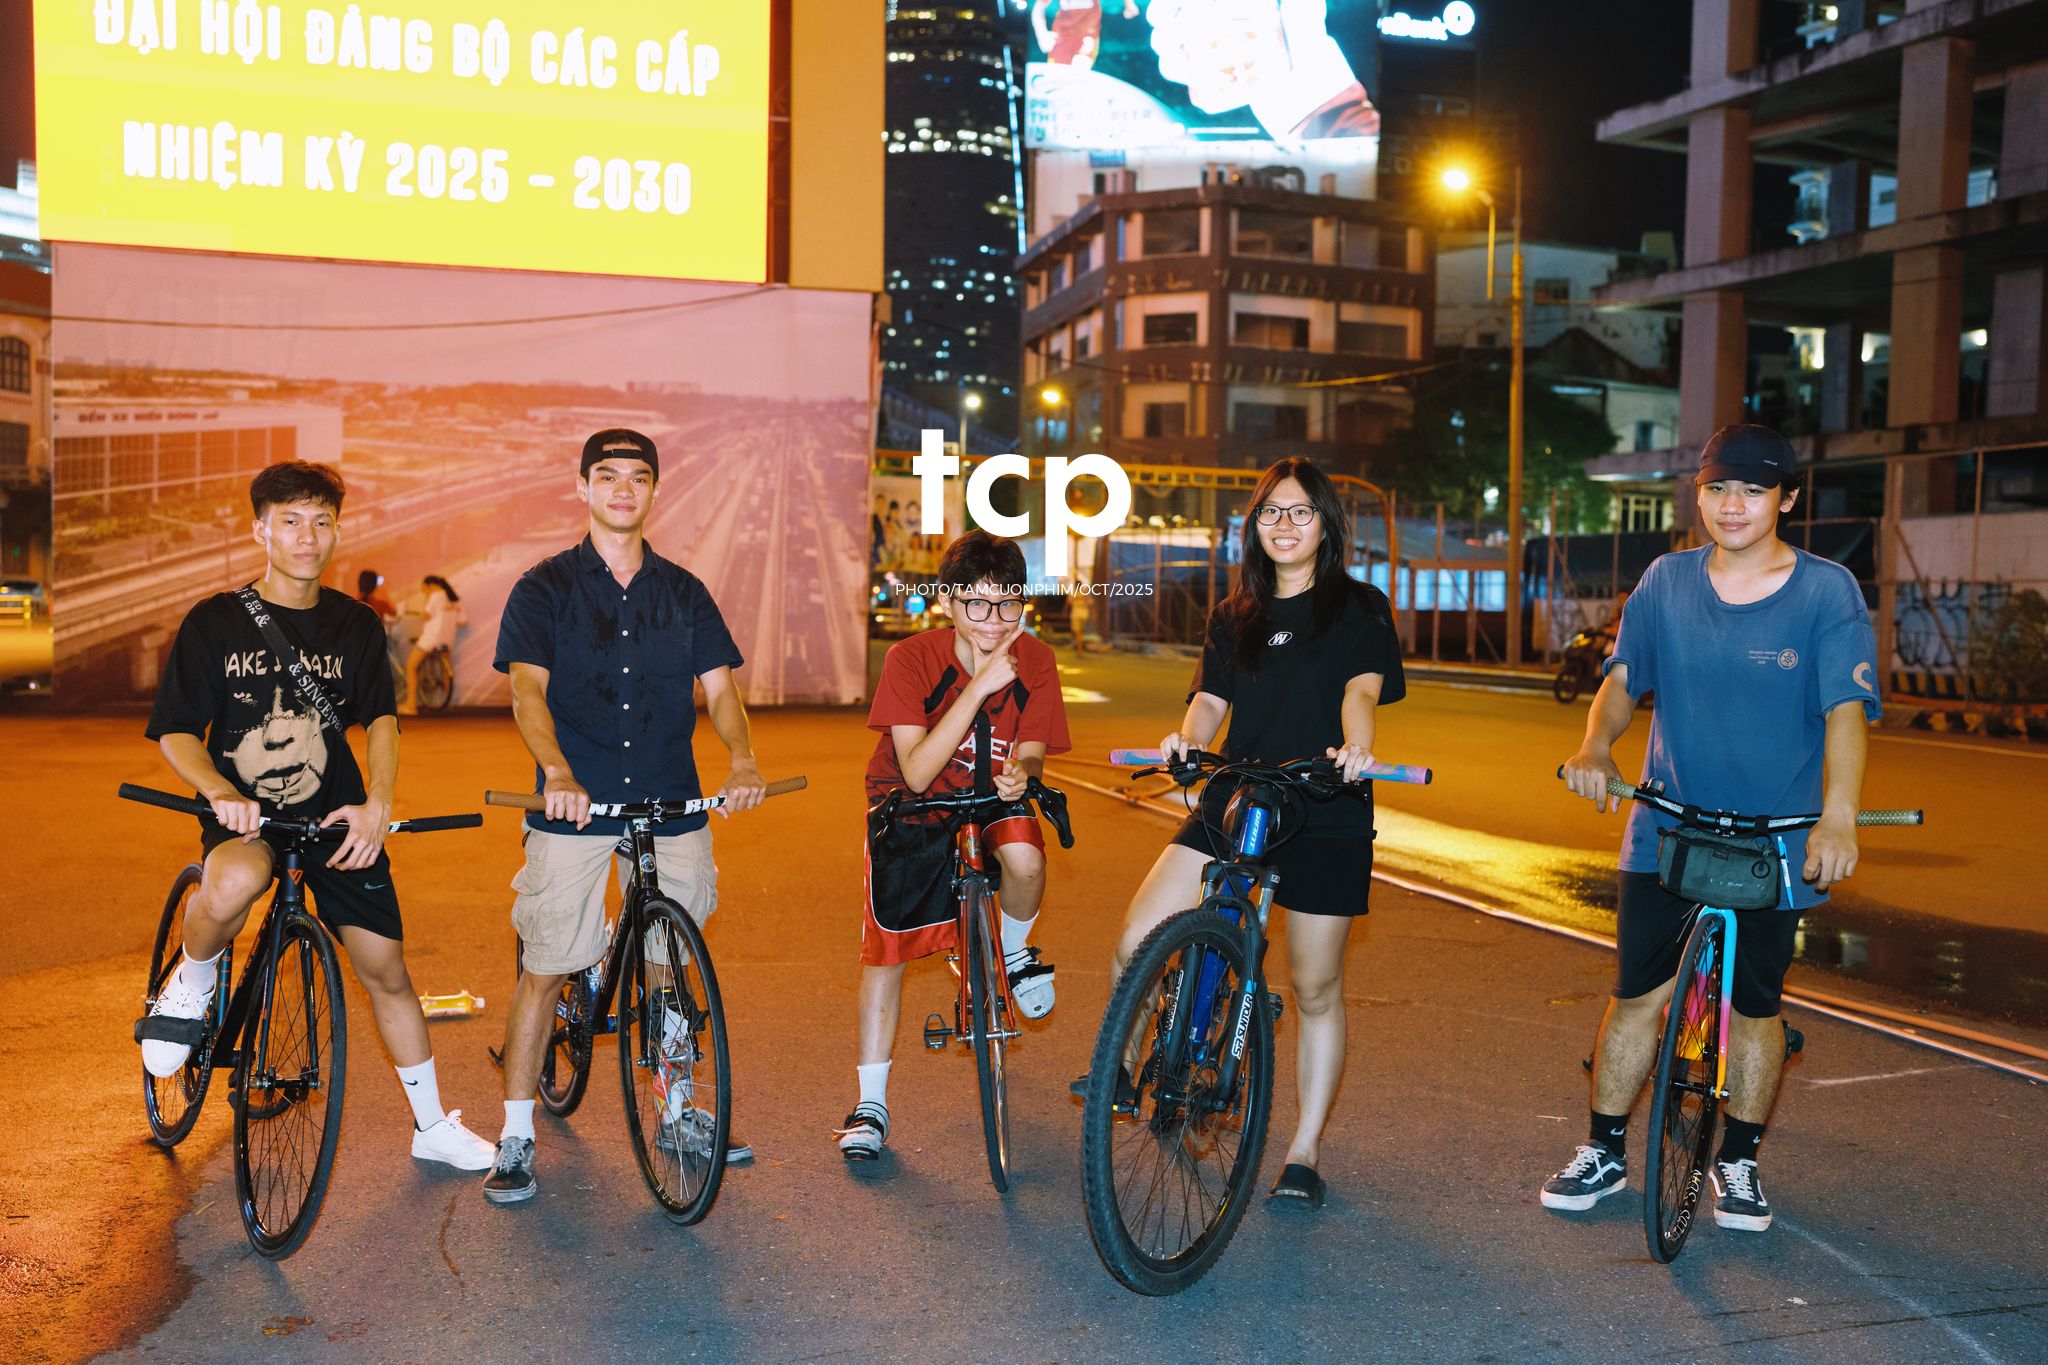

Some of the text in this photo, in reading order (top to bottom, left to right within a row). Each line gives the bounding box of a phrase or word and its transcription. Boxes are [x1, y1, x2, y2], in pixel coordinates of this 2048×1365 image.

[93, 0, 177, 55] ĐẠI
[201, 0, 281, 65] HỘI
[453, 18, 510, 87] BỘ
[530, 27, 617, 89] CÁC
[636, 29, 720, 97] CÁP
[123, 120, 283, 190] NHIỆM
[386, 142, 509, 203] 2025
[574, 156, 691, 215] 2030
